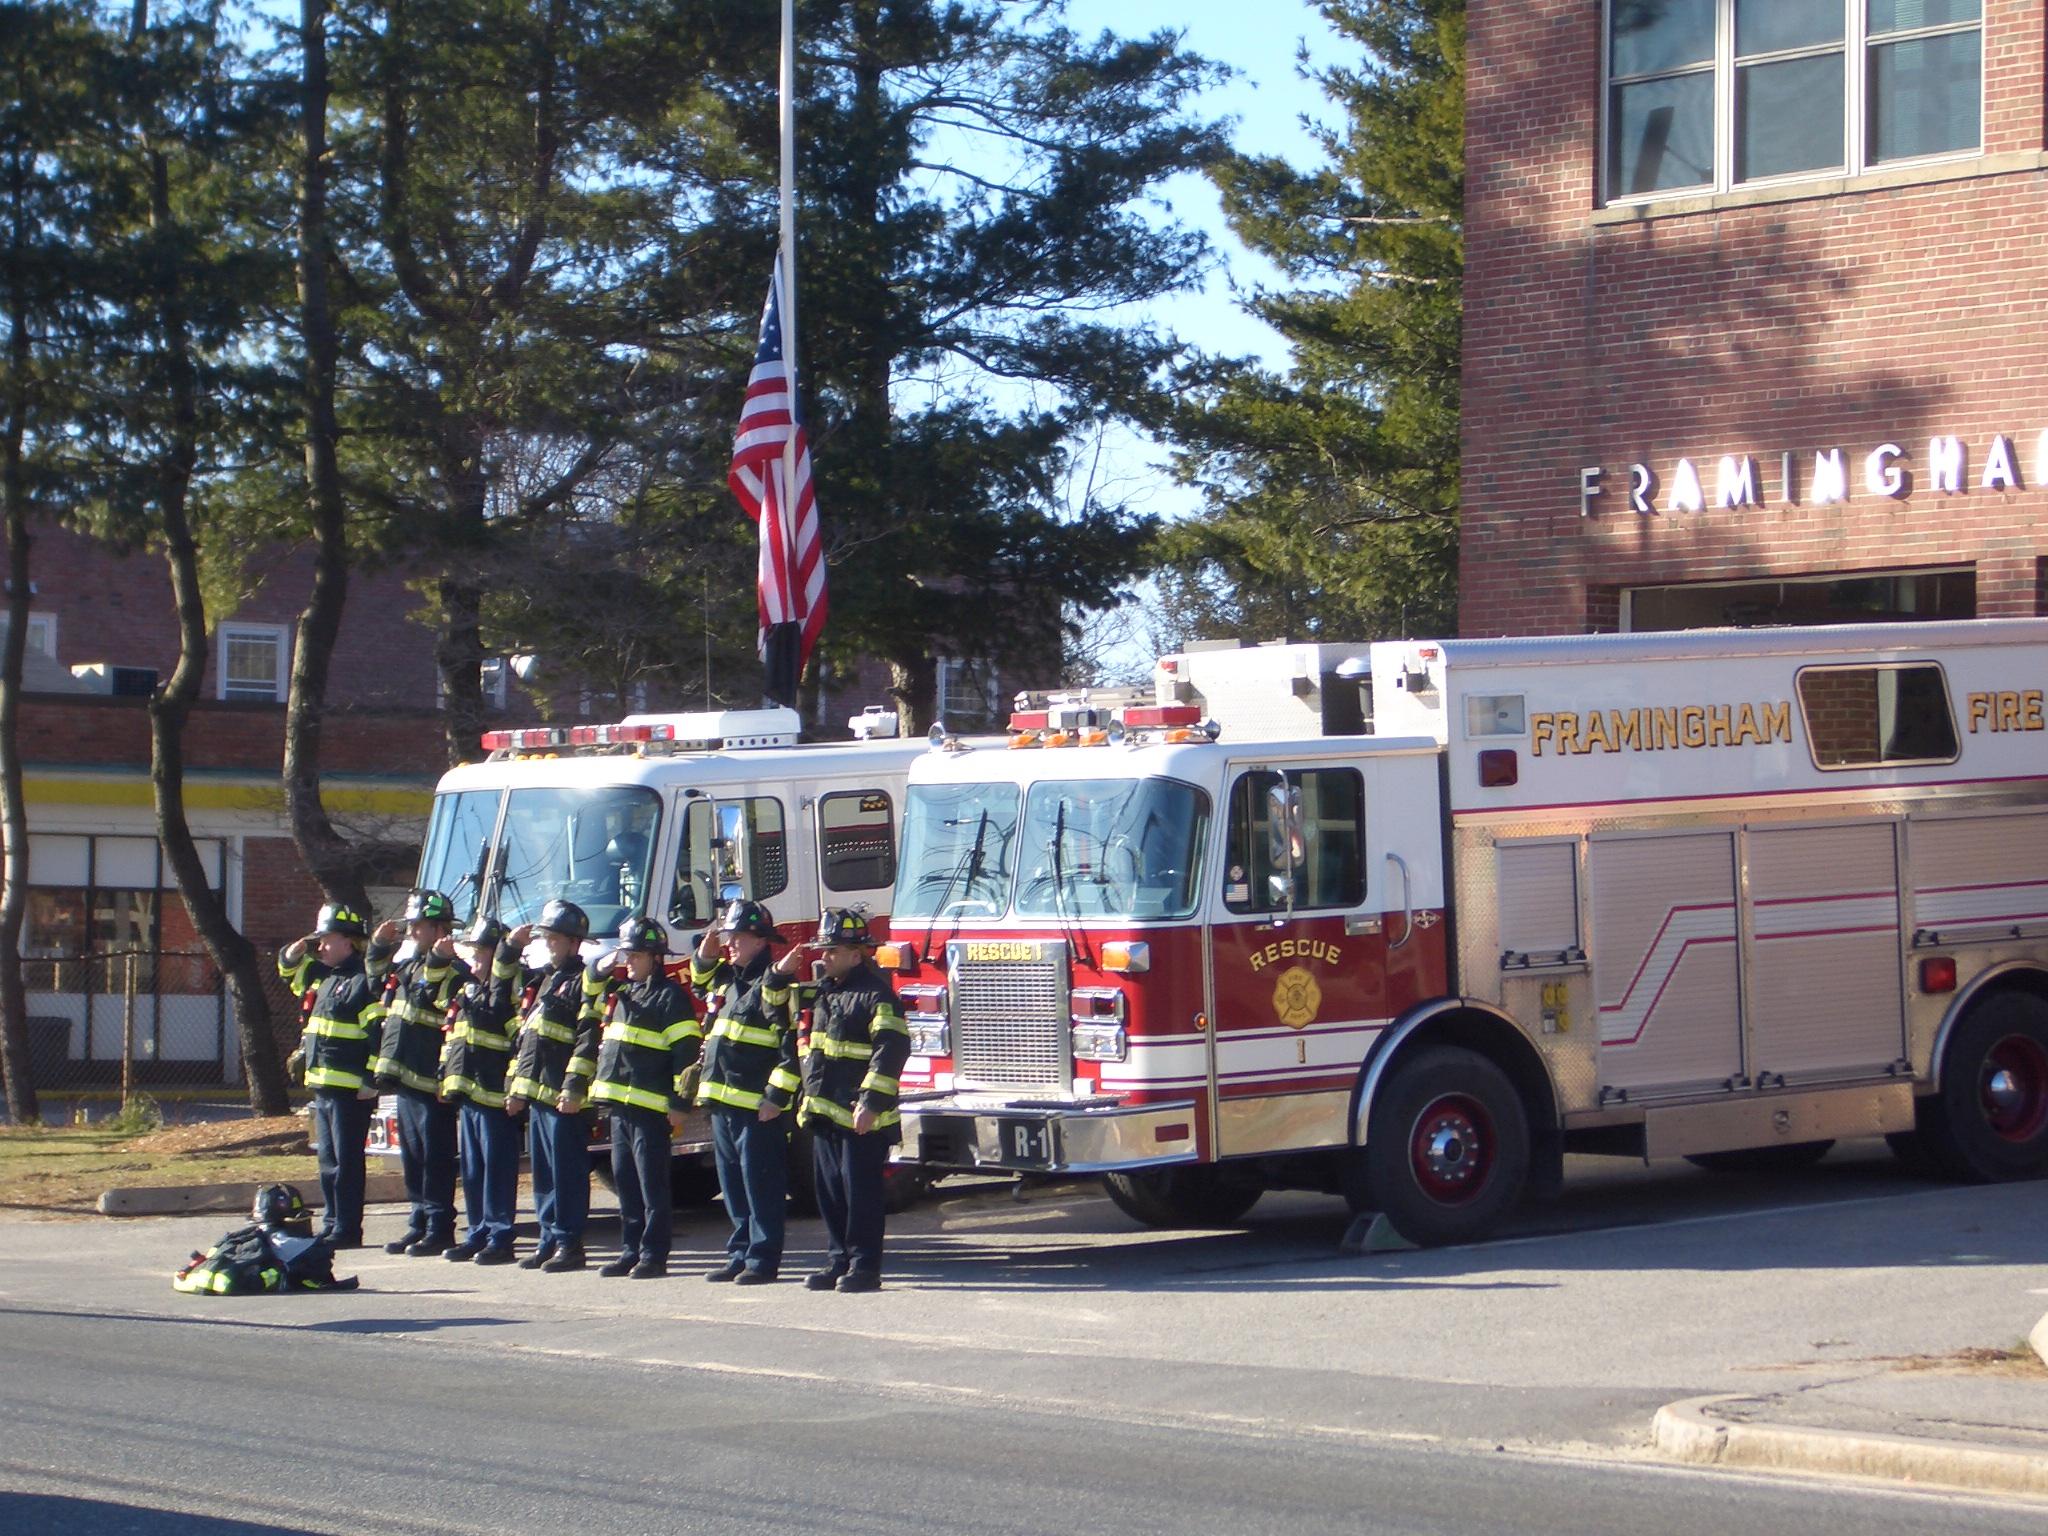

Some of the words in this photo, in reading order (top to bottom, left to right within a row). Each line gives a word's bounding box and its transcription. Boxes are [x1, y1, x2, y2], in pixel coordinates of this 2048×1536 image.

[1531, 701, 1792, 756] FRAMINGHAM
[1968, 690, 2044, 733] FIRE
[967, 943, 1032, 961] RESCUE
[1249, 939, 1341, 972] RESCUE
[1297, 1039, 1306, 1063] 1
[1014, 1126, 1048, 1158] R-1
